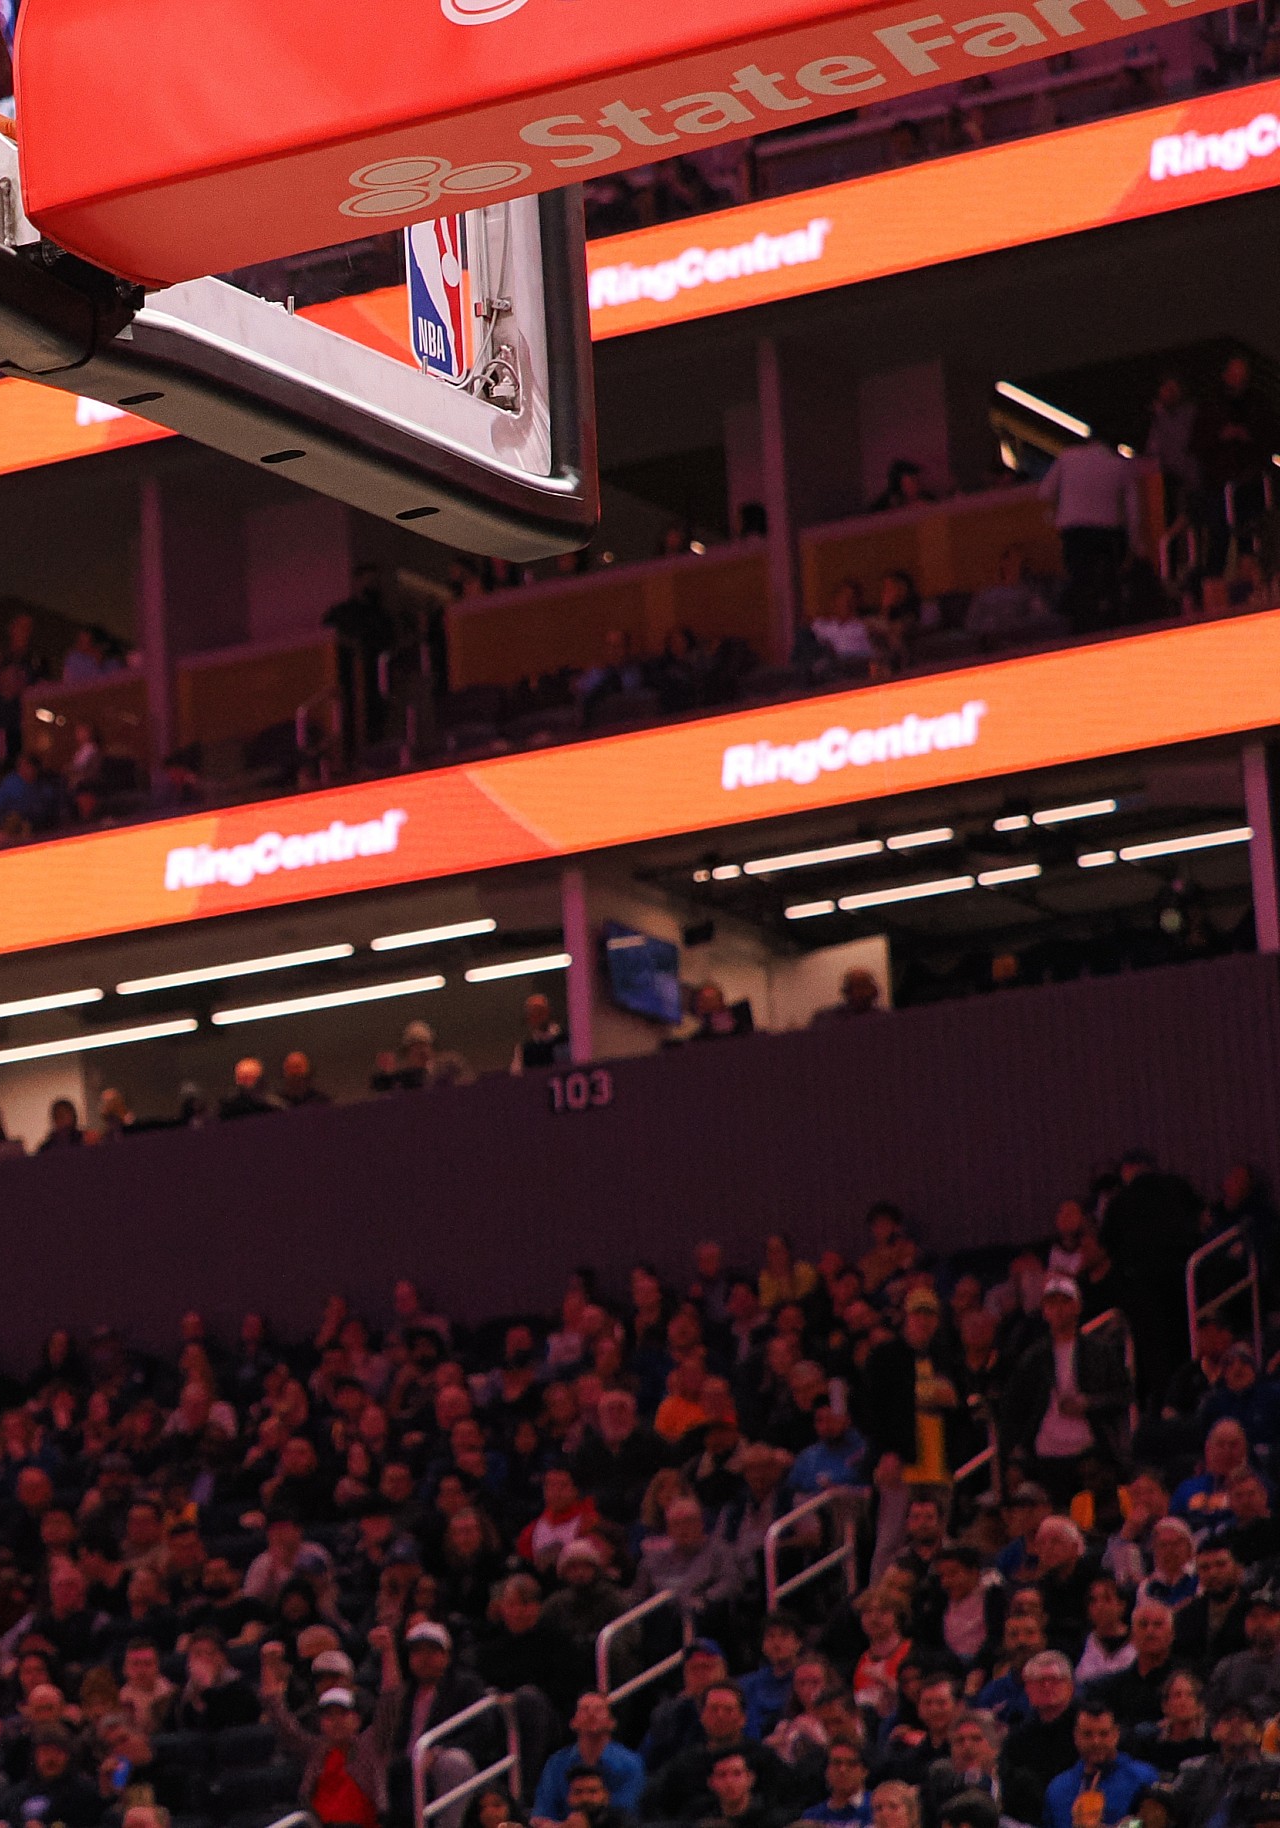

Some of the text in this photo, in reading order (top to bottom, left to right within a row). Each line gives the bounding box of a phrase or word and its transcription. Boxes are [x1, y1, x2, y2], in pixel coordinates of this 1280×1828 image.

[873, 0, 1197, 75] Far
[588, 217, 830, 310] RingCentral
[417, 316, 447, 363] NBA
[721, 700, 987, 791] RingCentral
[164, 808, 408, 891] RingCentral
[549, 1069, 613, 1113] 103
